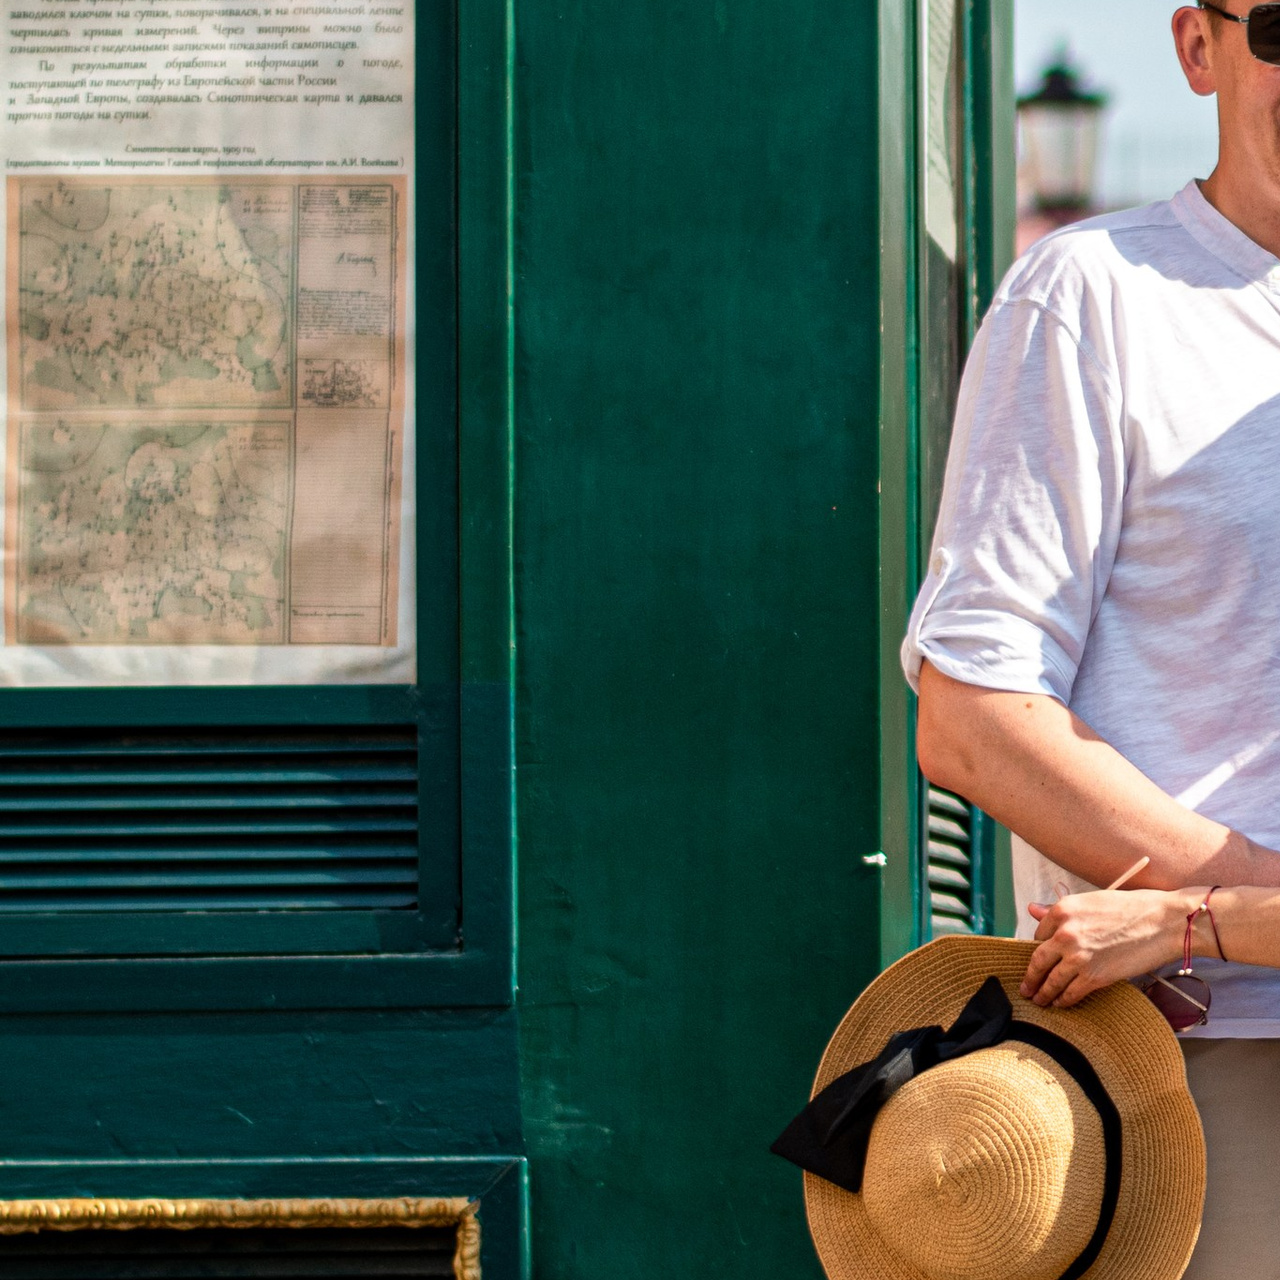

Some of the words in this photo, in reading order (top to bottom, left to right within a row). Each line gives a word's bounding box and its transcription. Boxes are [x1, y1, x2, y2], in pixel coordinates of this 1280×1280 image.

[10, 10, 66, 20] заводился
[70, 10, 112, 18] ключом
[117, 10, 130, 18] на
[134, 10, 172, 22] сутки,
[276, 8, 288, 16] на
[293, 6, 365, 18] специальной
[370, 6, 404, 16] ленте
[10, 28, 70, 40] чертилась
[82, 28, 122, 40] кривая
[213, 24, 244, 38] Через
[256, 25, 310, 36] витрины
[324, 24, 362, 34] можно
[374, 22, 403, 34] было
[10, 45, 90, 54] ознакомиться
[102, 44, 169, 54] недельными
[229, 40, 288, 50] показаний
[291, 41, 359, 52] самописцев.
[39, 60, 55, 72] По
[71, 60, 147, 74] результатам
[165, 56, 226, 71] обработки
[245, 56, 318, 71] информации
[362, 59, 404, 70] погоде,
[8, 78, 86, 92] поступающей
[90, 78, 104, 88] по
[106, 74, 165, 90] телеграфу
[168, 78, 180, 86] из
[184, 74, 254, 89] Европейской
[259, 77, 294, 86] части
[298, 74, 337, 86] России
[26, 94, 79, 106] Западной
[86, 92, 131, 106] Европы,
[136, 94, 202, 104] создавалась
[207, 92, 298, 103] Синоптическая
[304, 94, 340, 106] карта
[358, 94, 402, 105] давался
[8, 111, 52, 124] прогноз
[54, 111, 94, 122] погоды
[98, 111, 110, 120] на
[114, 111, 152, 124] сутки.
